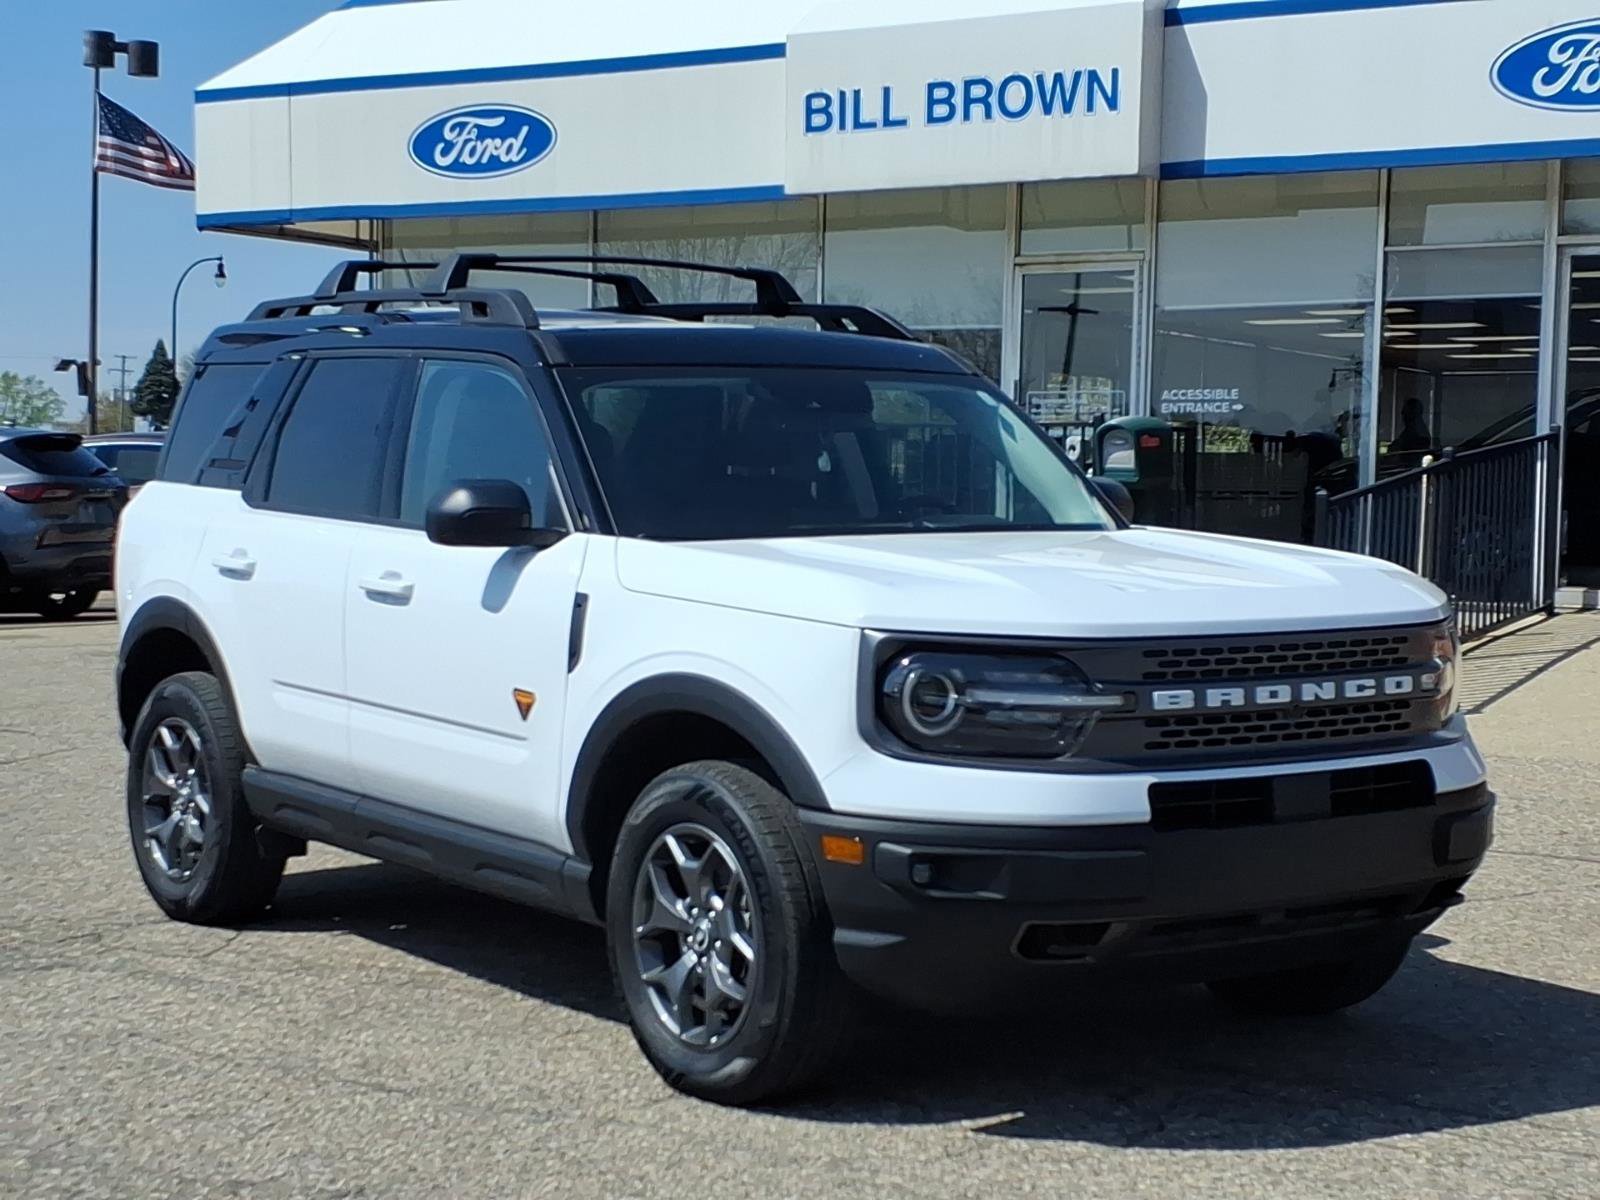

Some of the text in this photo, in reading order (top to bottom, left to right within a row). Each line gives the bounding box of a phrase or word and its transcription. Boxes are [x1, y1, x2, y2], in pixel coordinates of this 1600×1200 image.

[1532, 33, 1600, 97] Fo
[804, 67, 1119, 134] BILL BROWN
[434, 116, 530, 167] Ford
[1160, 402, 1230, 414] ENTRANCE
[1161, 388, 1240, 401] ACCESSIBLE
[1152, 675, 1414, 711] BRONCO
